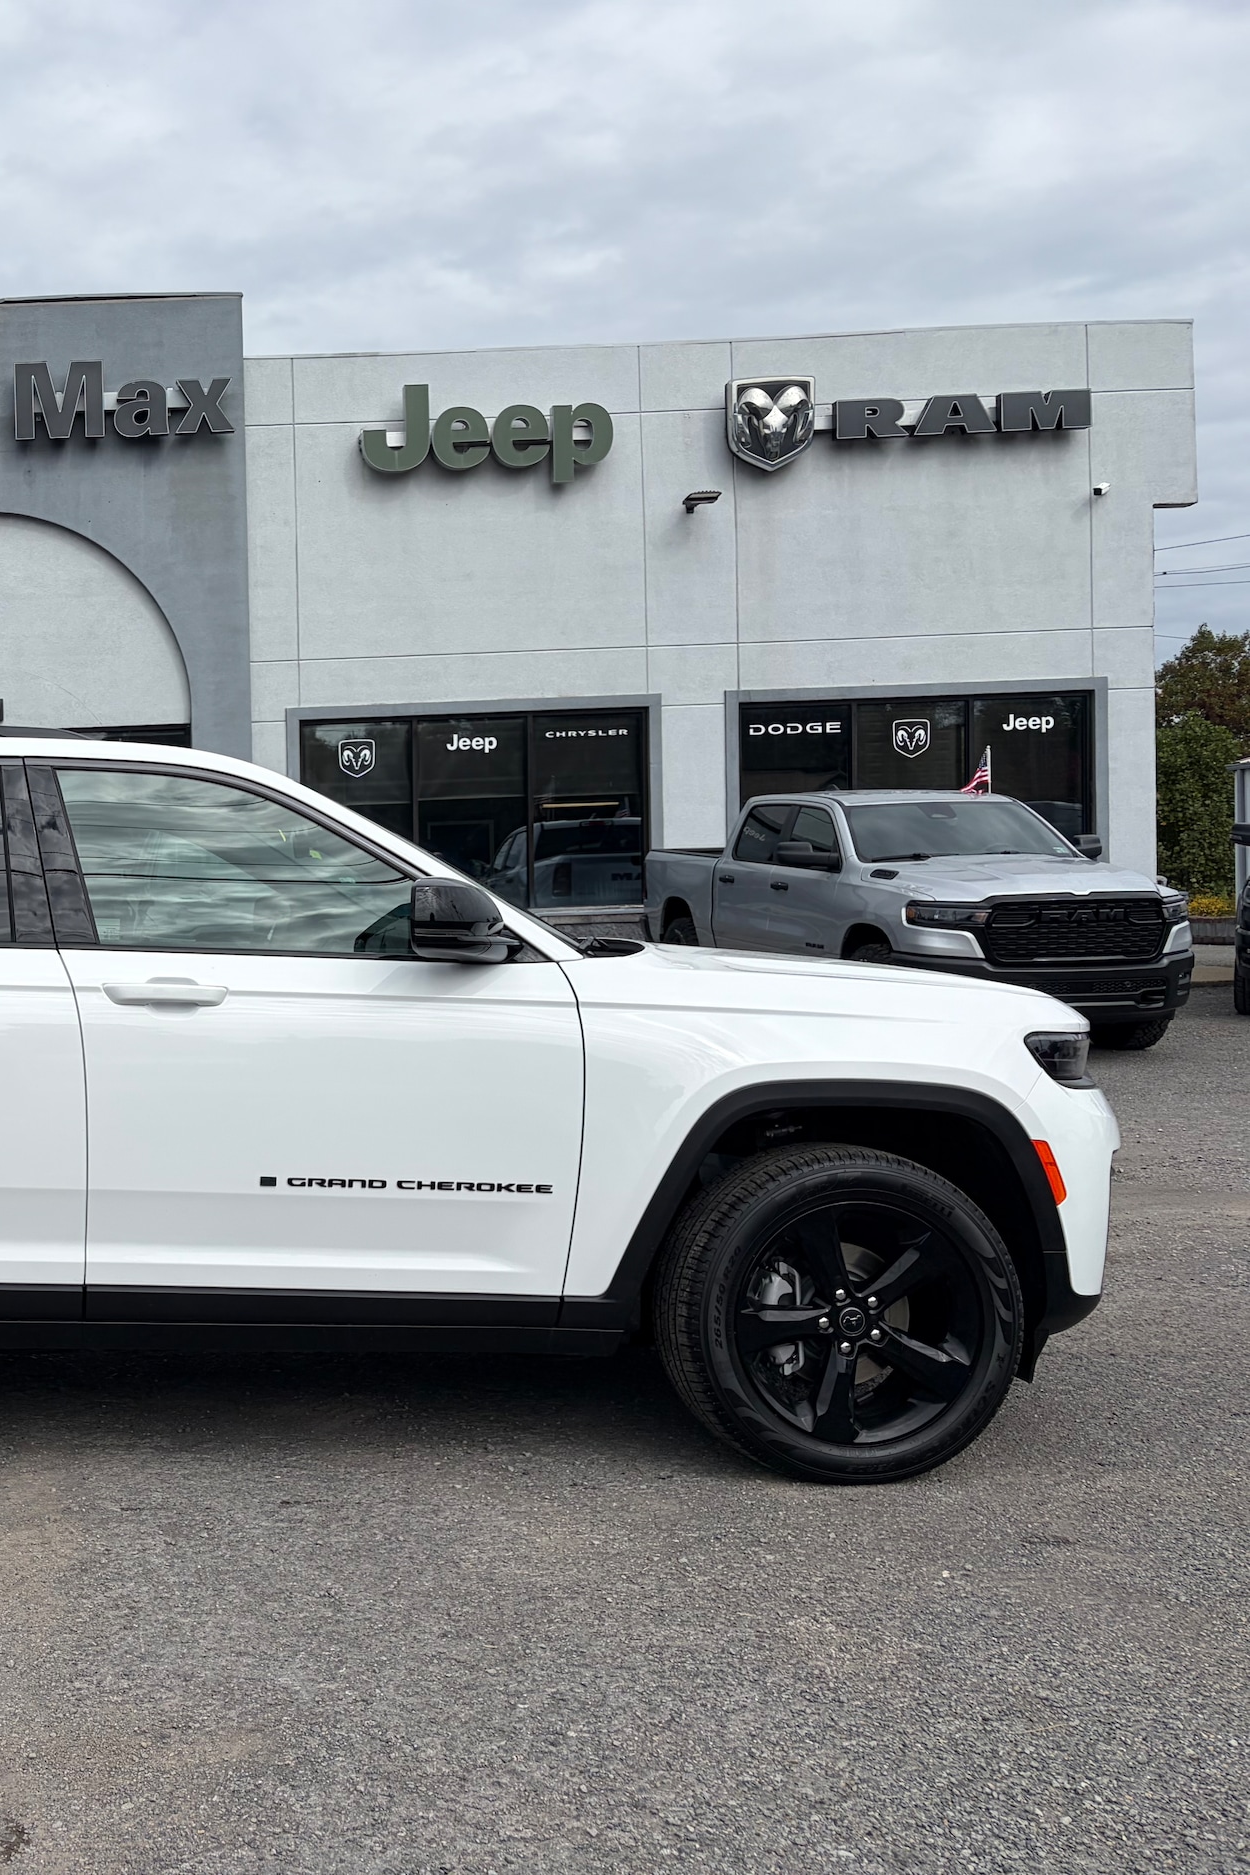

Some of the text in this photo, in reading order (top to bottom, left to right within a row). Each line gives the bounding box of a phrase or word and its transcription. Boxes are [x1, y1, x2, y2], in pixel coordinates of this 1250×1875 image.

[13, 360, 235, 441] Max
[832, 388, 1093, 440] RAM
[359, 384, 614, 483] Jeep
[748, 722, 842, 735] DODGE
[1002, 713, 1055, 733] Jeep
[545, 729, 629, 738] CHRYSLER
[446, 734, 498, 753] Jeep
[1041, 909, 1125, 921] RAM
[287, 1177, 553, 1194] GRAND CHEROKEE
